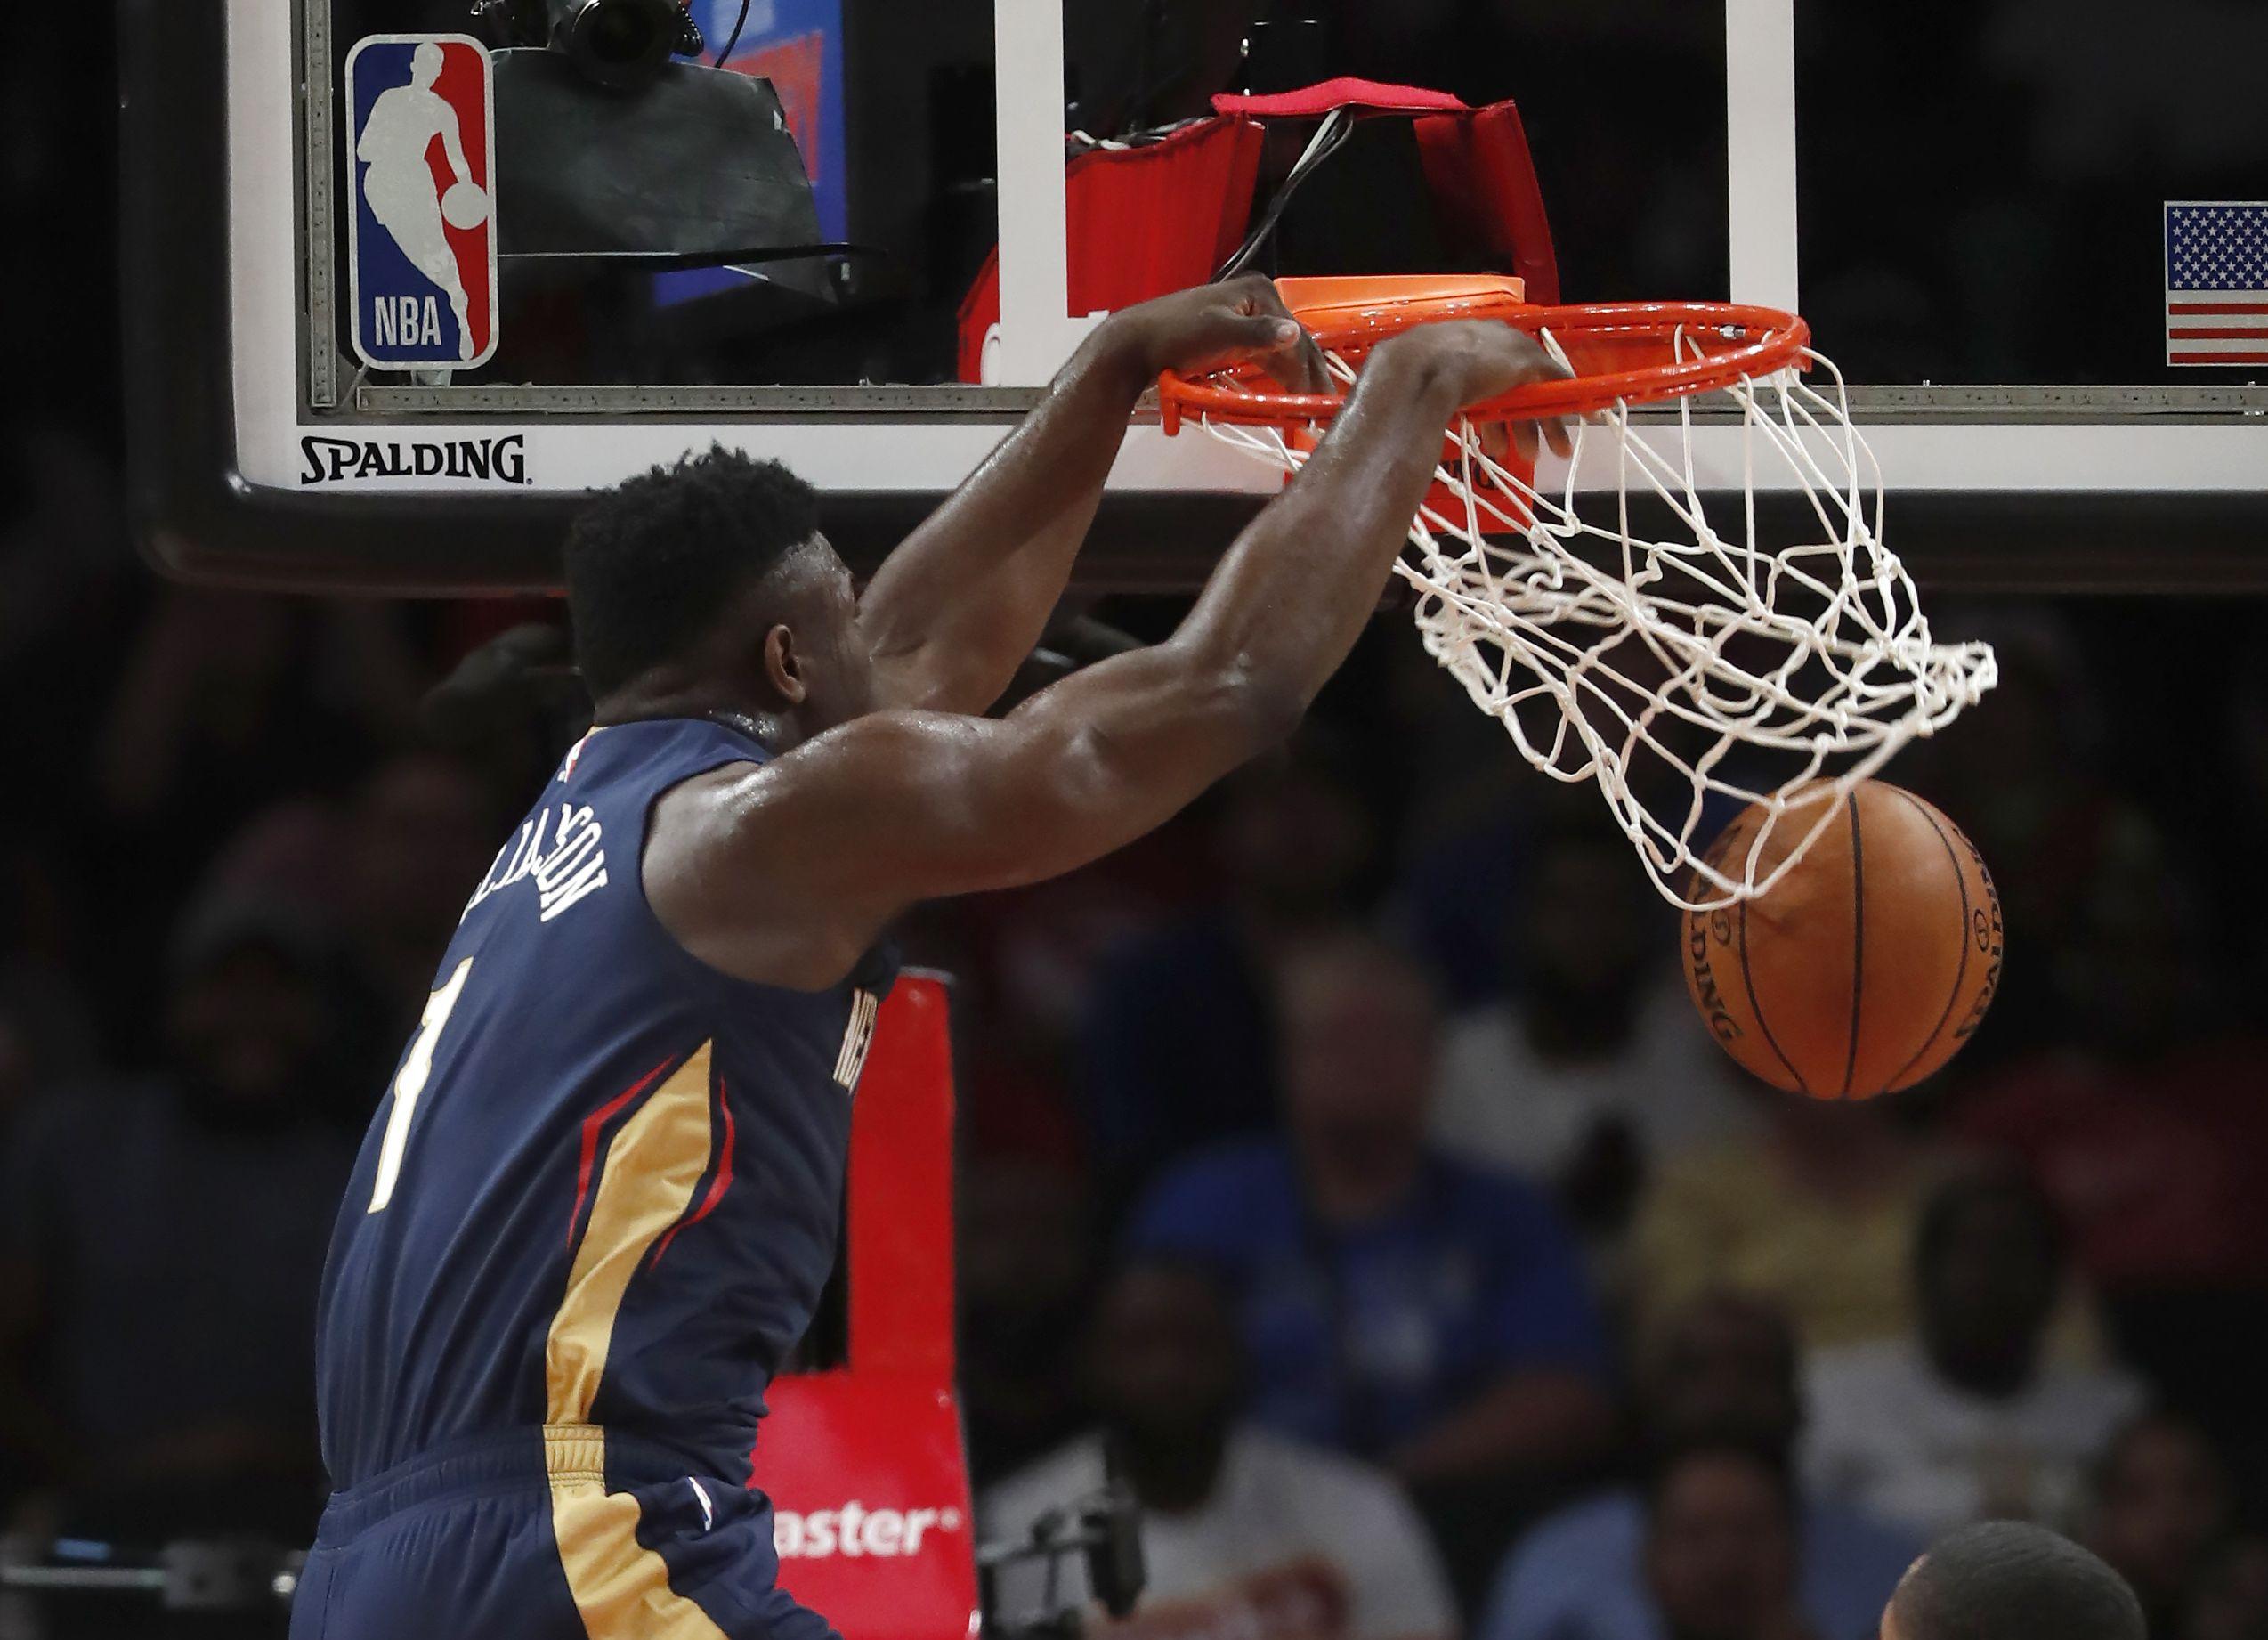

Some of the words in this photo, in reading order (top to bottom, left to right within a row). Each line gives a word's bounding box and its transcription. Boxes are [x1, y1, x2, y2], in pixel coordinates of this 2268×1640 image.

[375, 296, 442, 345] NBA
[301, 434, 525, 484] SPALDING
[367, 955, 474, 1215] 1
